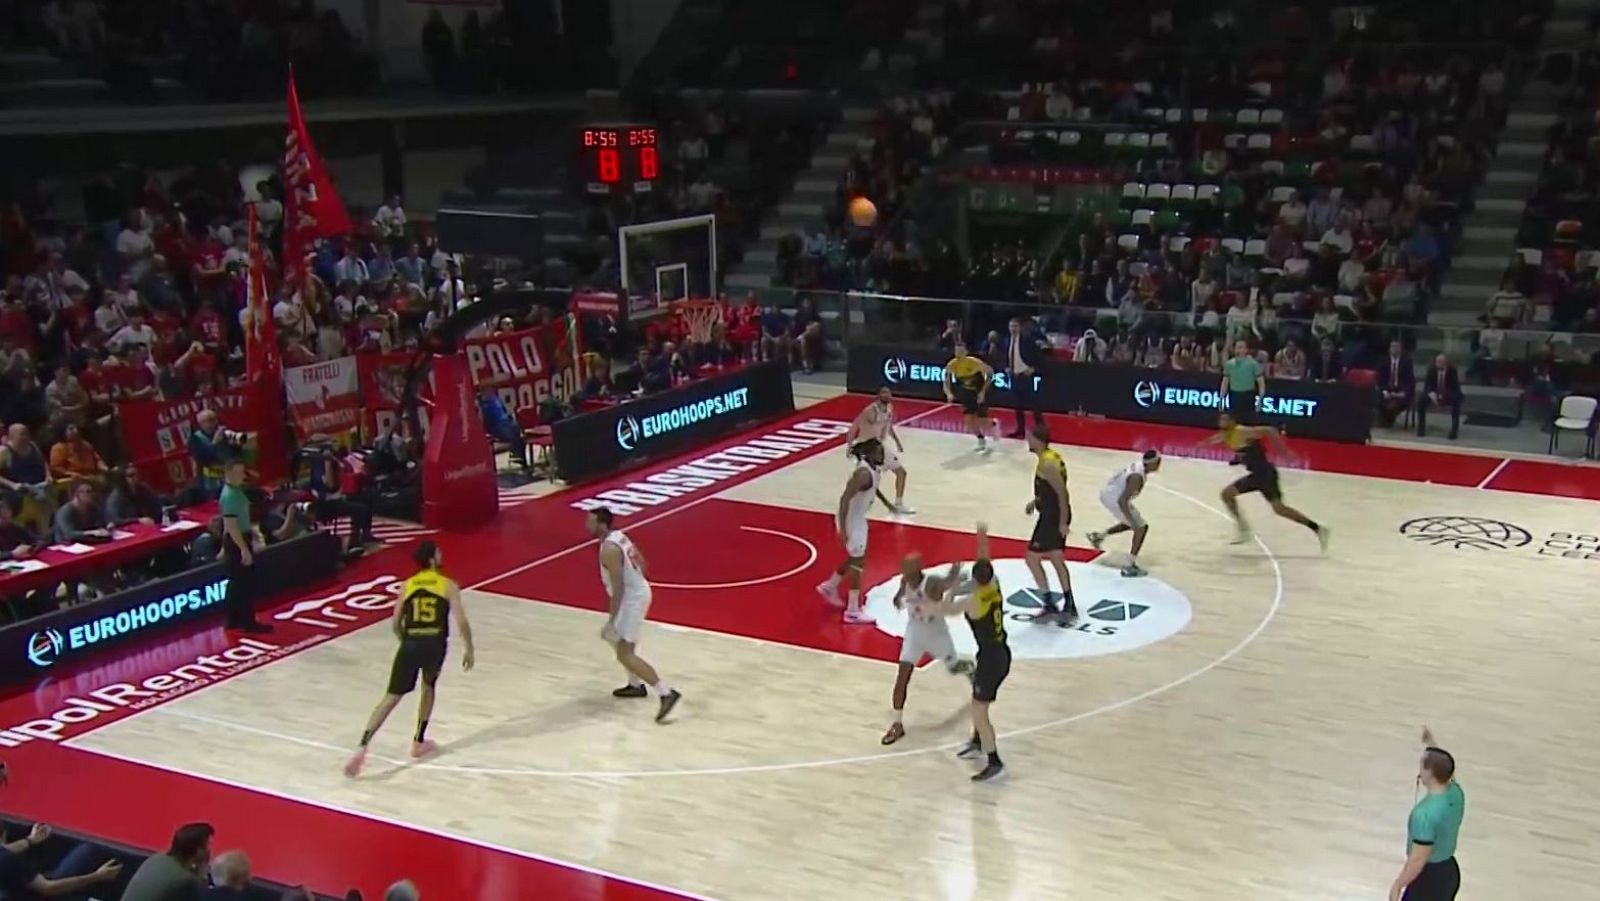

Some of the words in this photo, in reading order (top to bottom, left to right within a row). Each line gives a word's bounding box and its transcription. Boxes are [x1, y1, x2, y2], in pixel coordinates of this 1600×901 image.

[600, 149, 620, 182] 8
[641, 147, 656, 179] 8
[303, 362, 341, 384] FRATELLI
[466, 336, 543, 386] POLO
[641, 387, 749, 438] EUROHOOPS.NET
[69, 578, 230, 649] EUROHOOPS.N
[412, 597, 438, 623] 15
